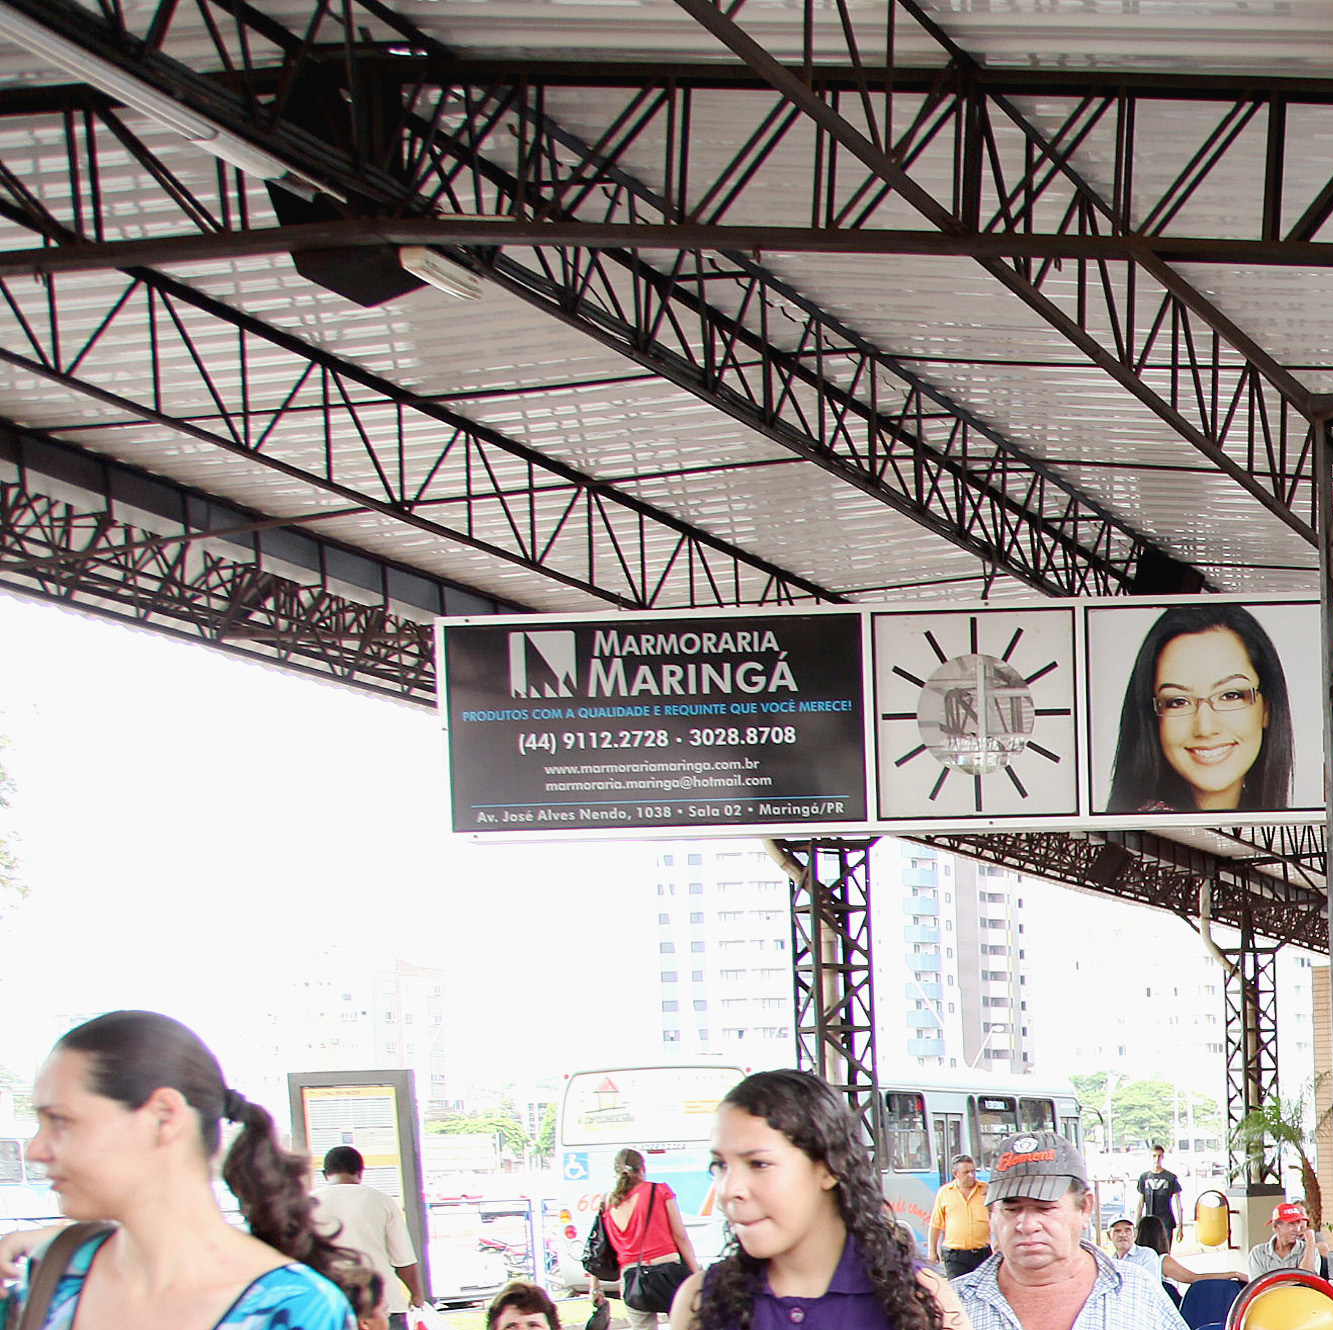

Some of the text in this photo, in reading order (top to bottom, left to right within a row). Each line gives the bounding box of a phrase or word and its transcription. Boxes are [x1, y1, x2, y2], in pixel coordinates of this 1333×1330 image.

[594, 630, 780, 657] MARMORARIA
[588, 652, 799, 698] MARINGÁ
[462, 699, 853, 722] PRODUTOS COM A QUALIDADE E REQUINTE QUE VOCÊ MERECE!
[518, 726, 797, 755] (44) 9112.2728 3028.8708
[544, 757, 760, 775] www.marmorariamaringa.com.br
[545, 774, 773, 792] marmoraria.maringa@hotmail.com
[477, 801, 845, 824] Av. José Alves Nendo, 1038 Sala 02 Maringá/PR
